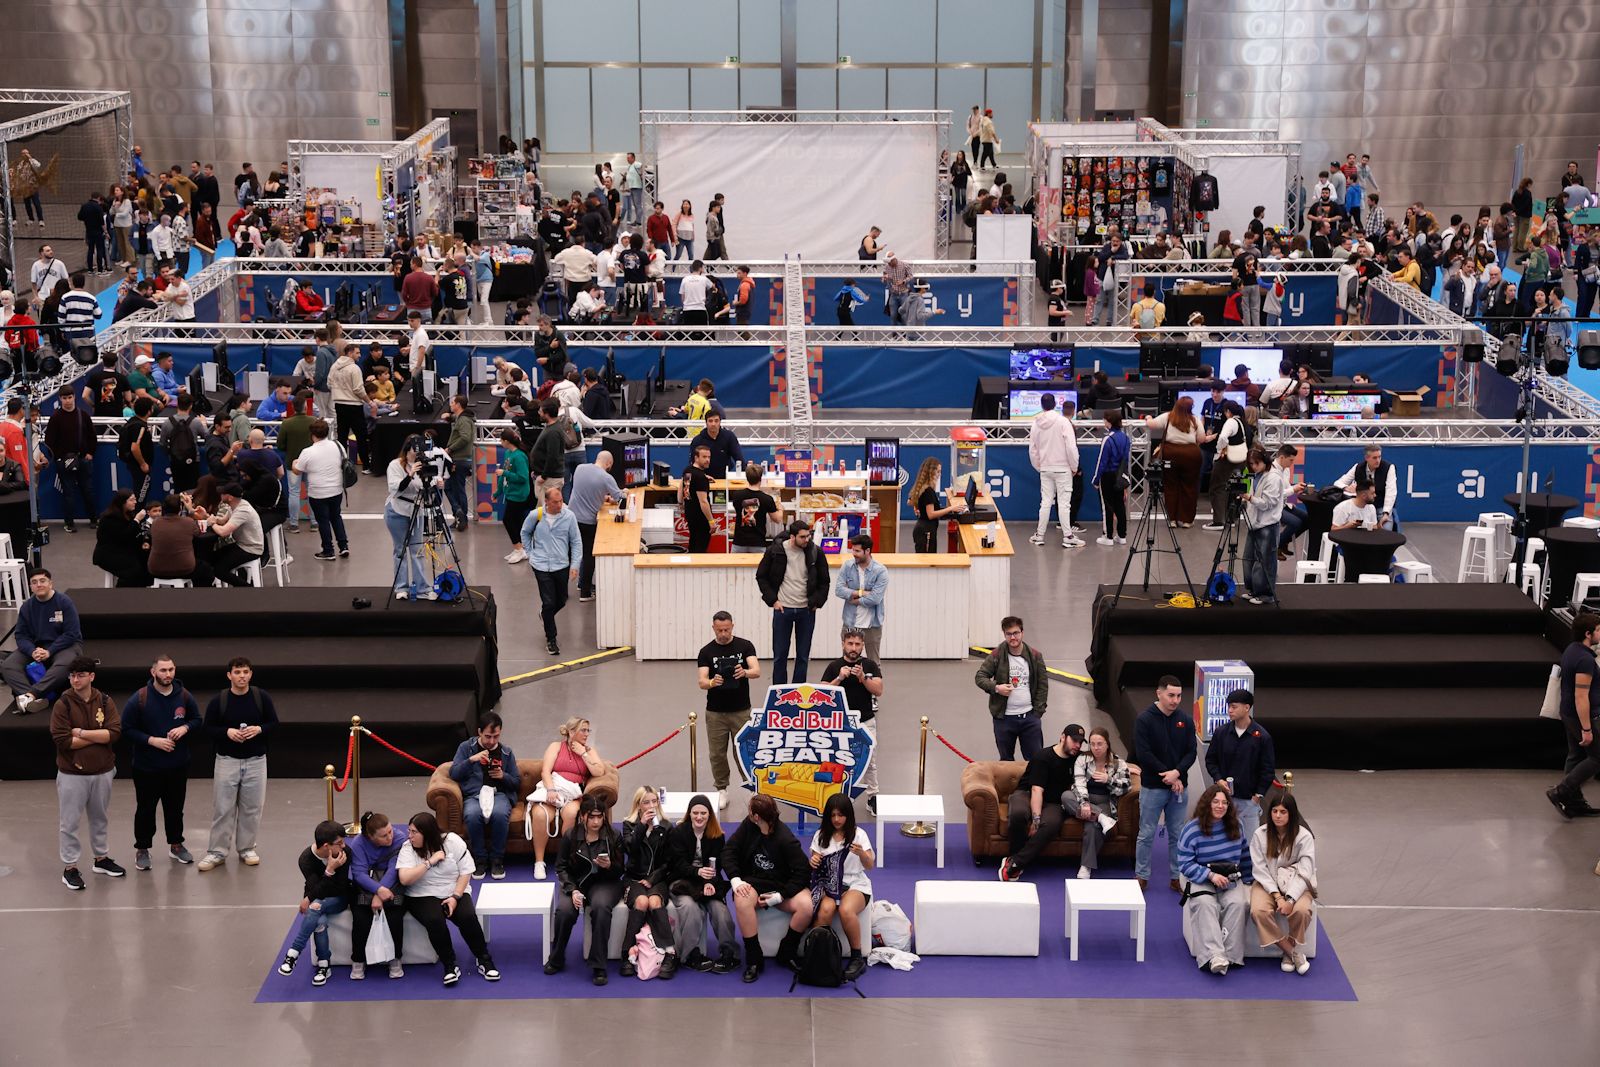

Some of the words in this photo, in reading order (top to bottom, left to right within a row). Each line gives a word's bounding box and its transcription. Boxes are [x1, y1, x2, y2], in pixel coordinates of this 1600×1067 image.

[1033, 359, 1047, 373] 8
[766, 709, 805, 730] Red
[806, 710, 844, 731] Bull
[757, 730, 855, 751] BEST
[753, 747, 856, 767] SEATS
